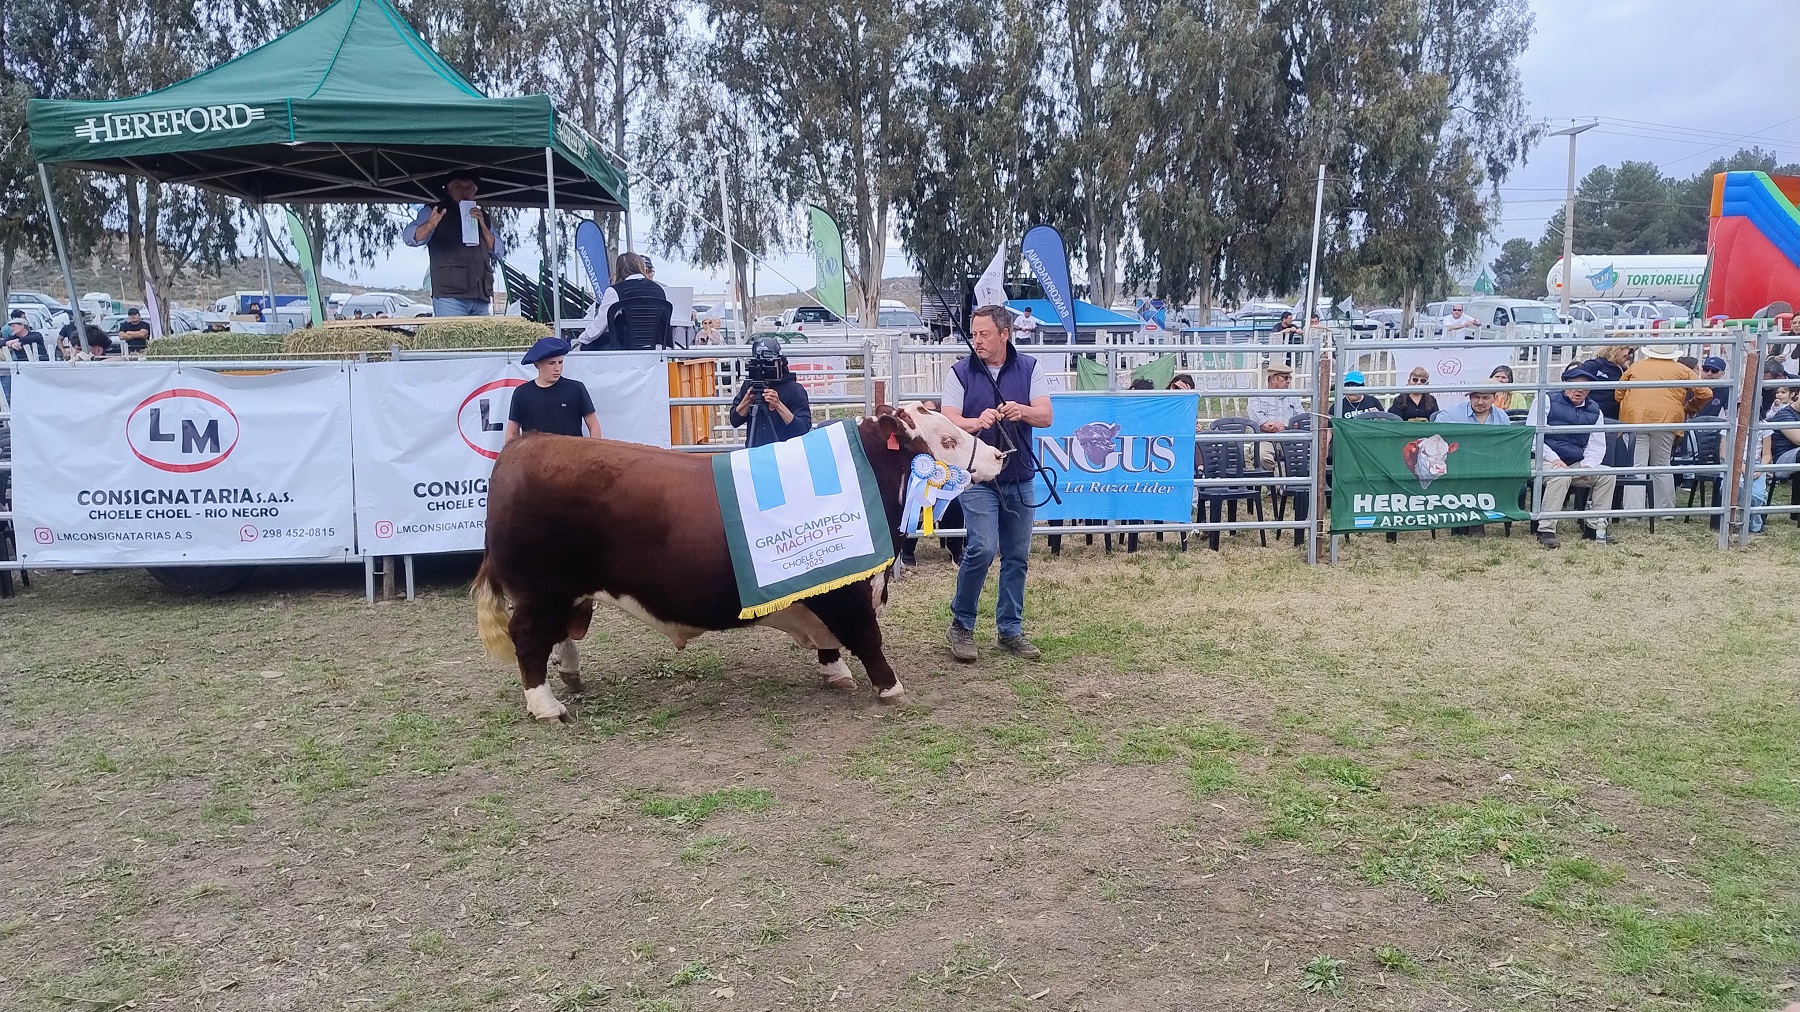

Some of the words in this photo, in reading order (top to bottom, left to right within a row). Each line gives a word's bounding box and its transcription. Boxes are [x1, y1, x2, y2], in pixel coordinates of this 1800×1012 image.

[83, 103, 255, 144] HEREFORD
[1626, 273, 1704, 286] TORTORIELLO
[480, 398, 504, 431] L
[150, 408, 220, 453] LM
[1035, 421, 1176, 473] NGUS
[77, 488, 255, 506] CONSIGNATARIA
[256, 491, 294, 504] S.A.S.
[413, 478, 488, 498] CONSIG
[1064, 482, 1084, 494] La
[1088, 482, 1128, 494] Raza
[427, 498, 474, 511] CHOELE
[1353, 493, 1496, 513] HEREFORD
[88, 509, 143, 520] CHOELE
[146, 508, 192, 519] CHOEL
[204, 508, 228, 518] RIO
[231, 507, 279, 518] NEGRO
[1380, 511, 1481, 528] ARGENTINA
[262, 529, 282, 539] 298
[285, 527, 336, 538] 452-0815
[396, 520, 486, 534] LMCONSIGNATAR
[755, 528, 793, 549] GRAN
[794, 511, 861, 536] CAMPEÓN
[775, 529, 823, 555] MACHO
[826, 524, 843, 536] PP
[782, 551, 814, 570] CHOELE
[815, 542, 847, 557] CHOEL
[804, 557, 824, 571] 2025
